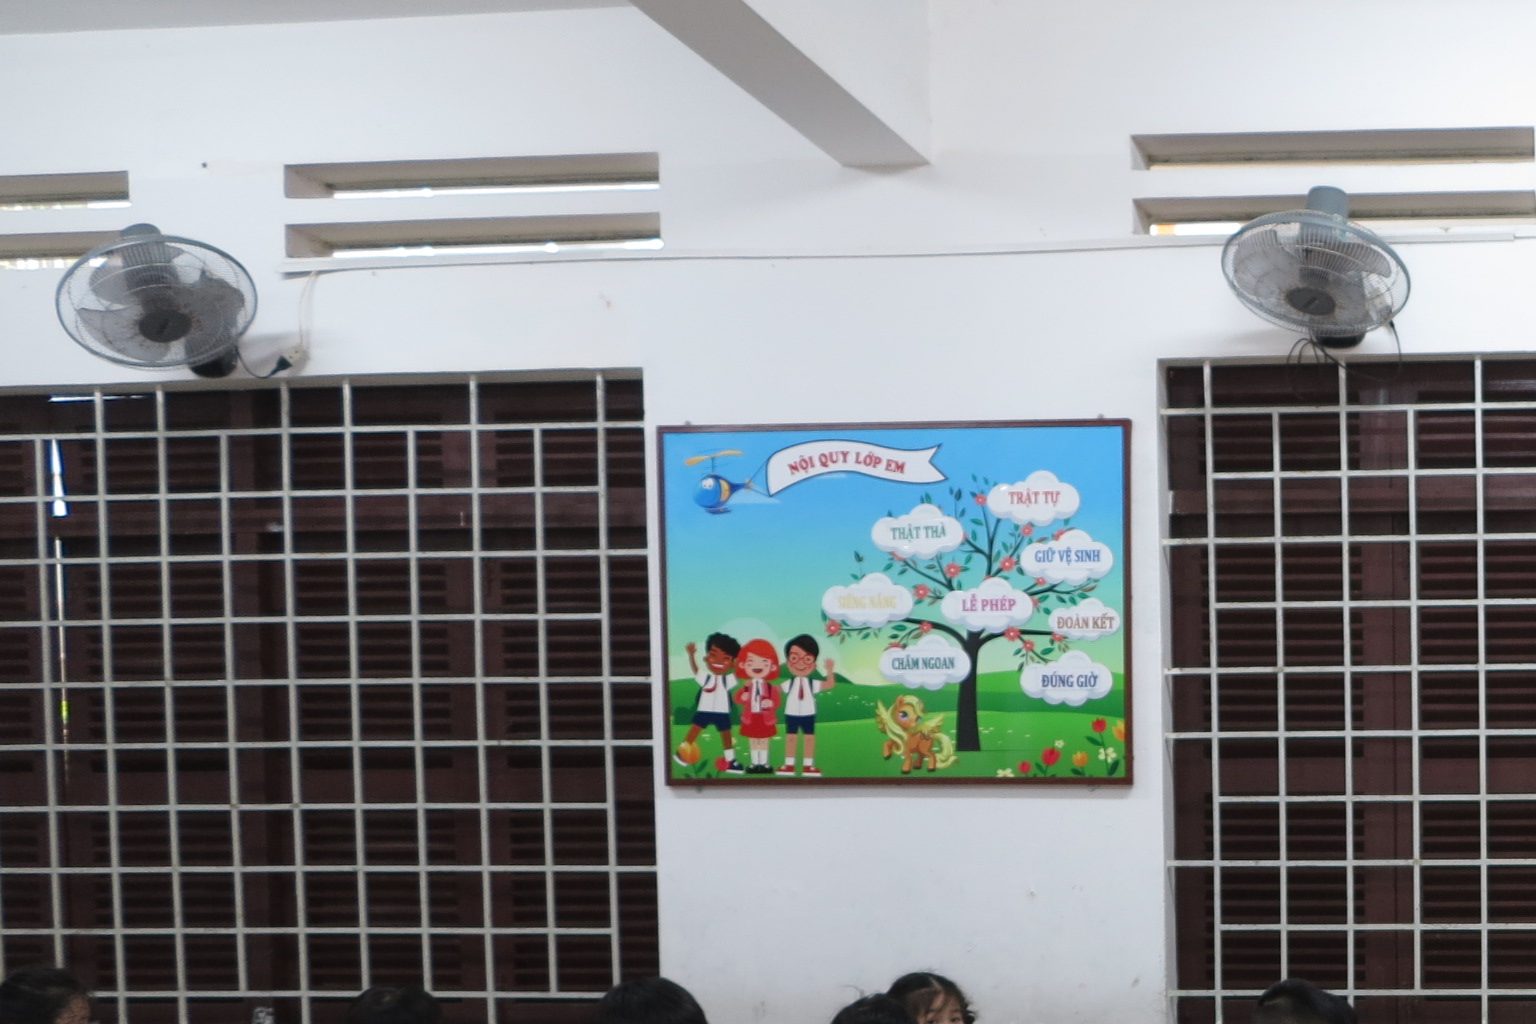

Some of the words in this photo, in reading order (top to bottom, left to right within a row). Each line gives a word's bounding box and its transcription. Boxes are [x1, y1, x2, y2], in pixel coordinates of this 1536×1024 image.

[787, 454, 815, 475] NỘI
[819, 450, 851, 467] QUY
[854, 450, 882, 468] LỚP
[885, 459, 907, 474] EM
[1008, 488, 1040, 512] TRẬT
[1042, 490, 1061, 510] TỰ
[890, 523, 921, 544] THẬT
[923, 523, 947, 539] THÀ
[1034, 549, 1056, 564] GIỮ
[1058, 545, 1073, 565] VỆ
[1074, 549, 1101, 563] SINH
[838, 594, 866, 611] SIÊNG
[961, 594, 978, 612] LỄ
[981, 595, 1017, 612] PHÉP
[1056, 614, 1089, 630] ĐOÀN
[1092, 612, 1115, 630] KẾT
[891, 656, 920, 670] CHĂM
[921, 657, 955, 670] NGOAN
[1041, 671, 1075, 688] ĐÚNG
[1077, 672, 1098, 688] GIỜ
